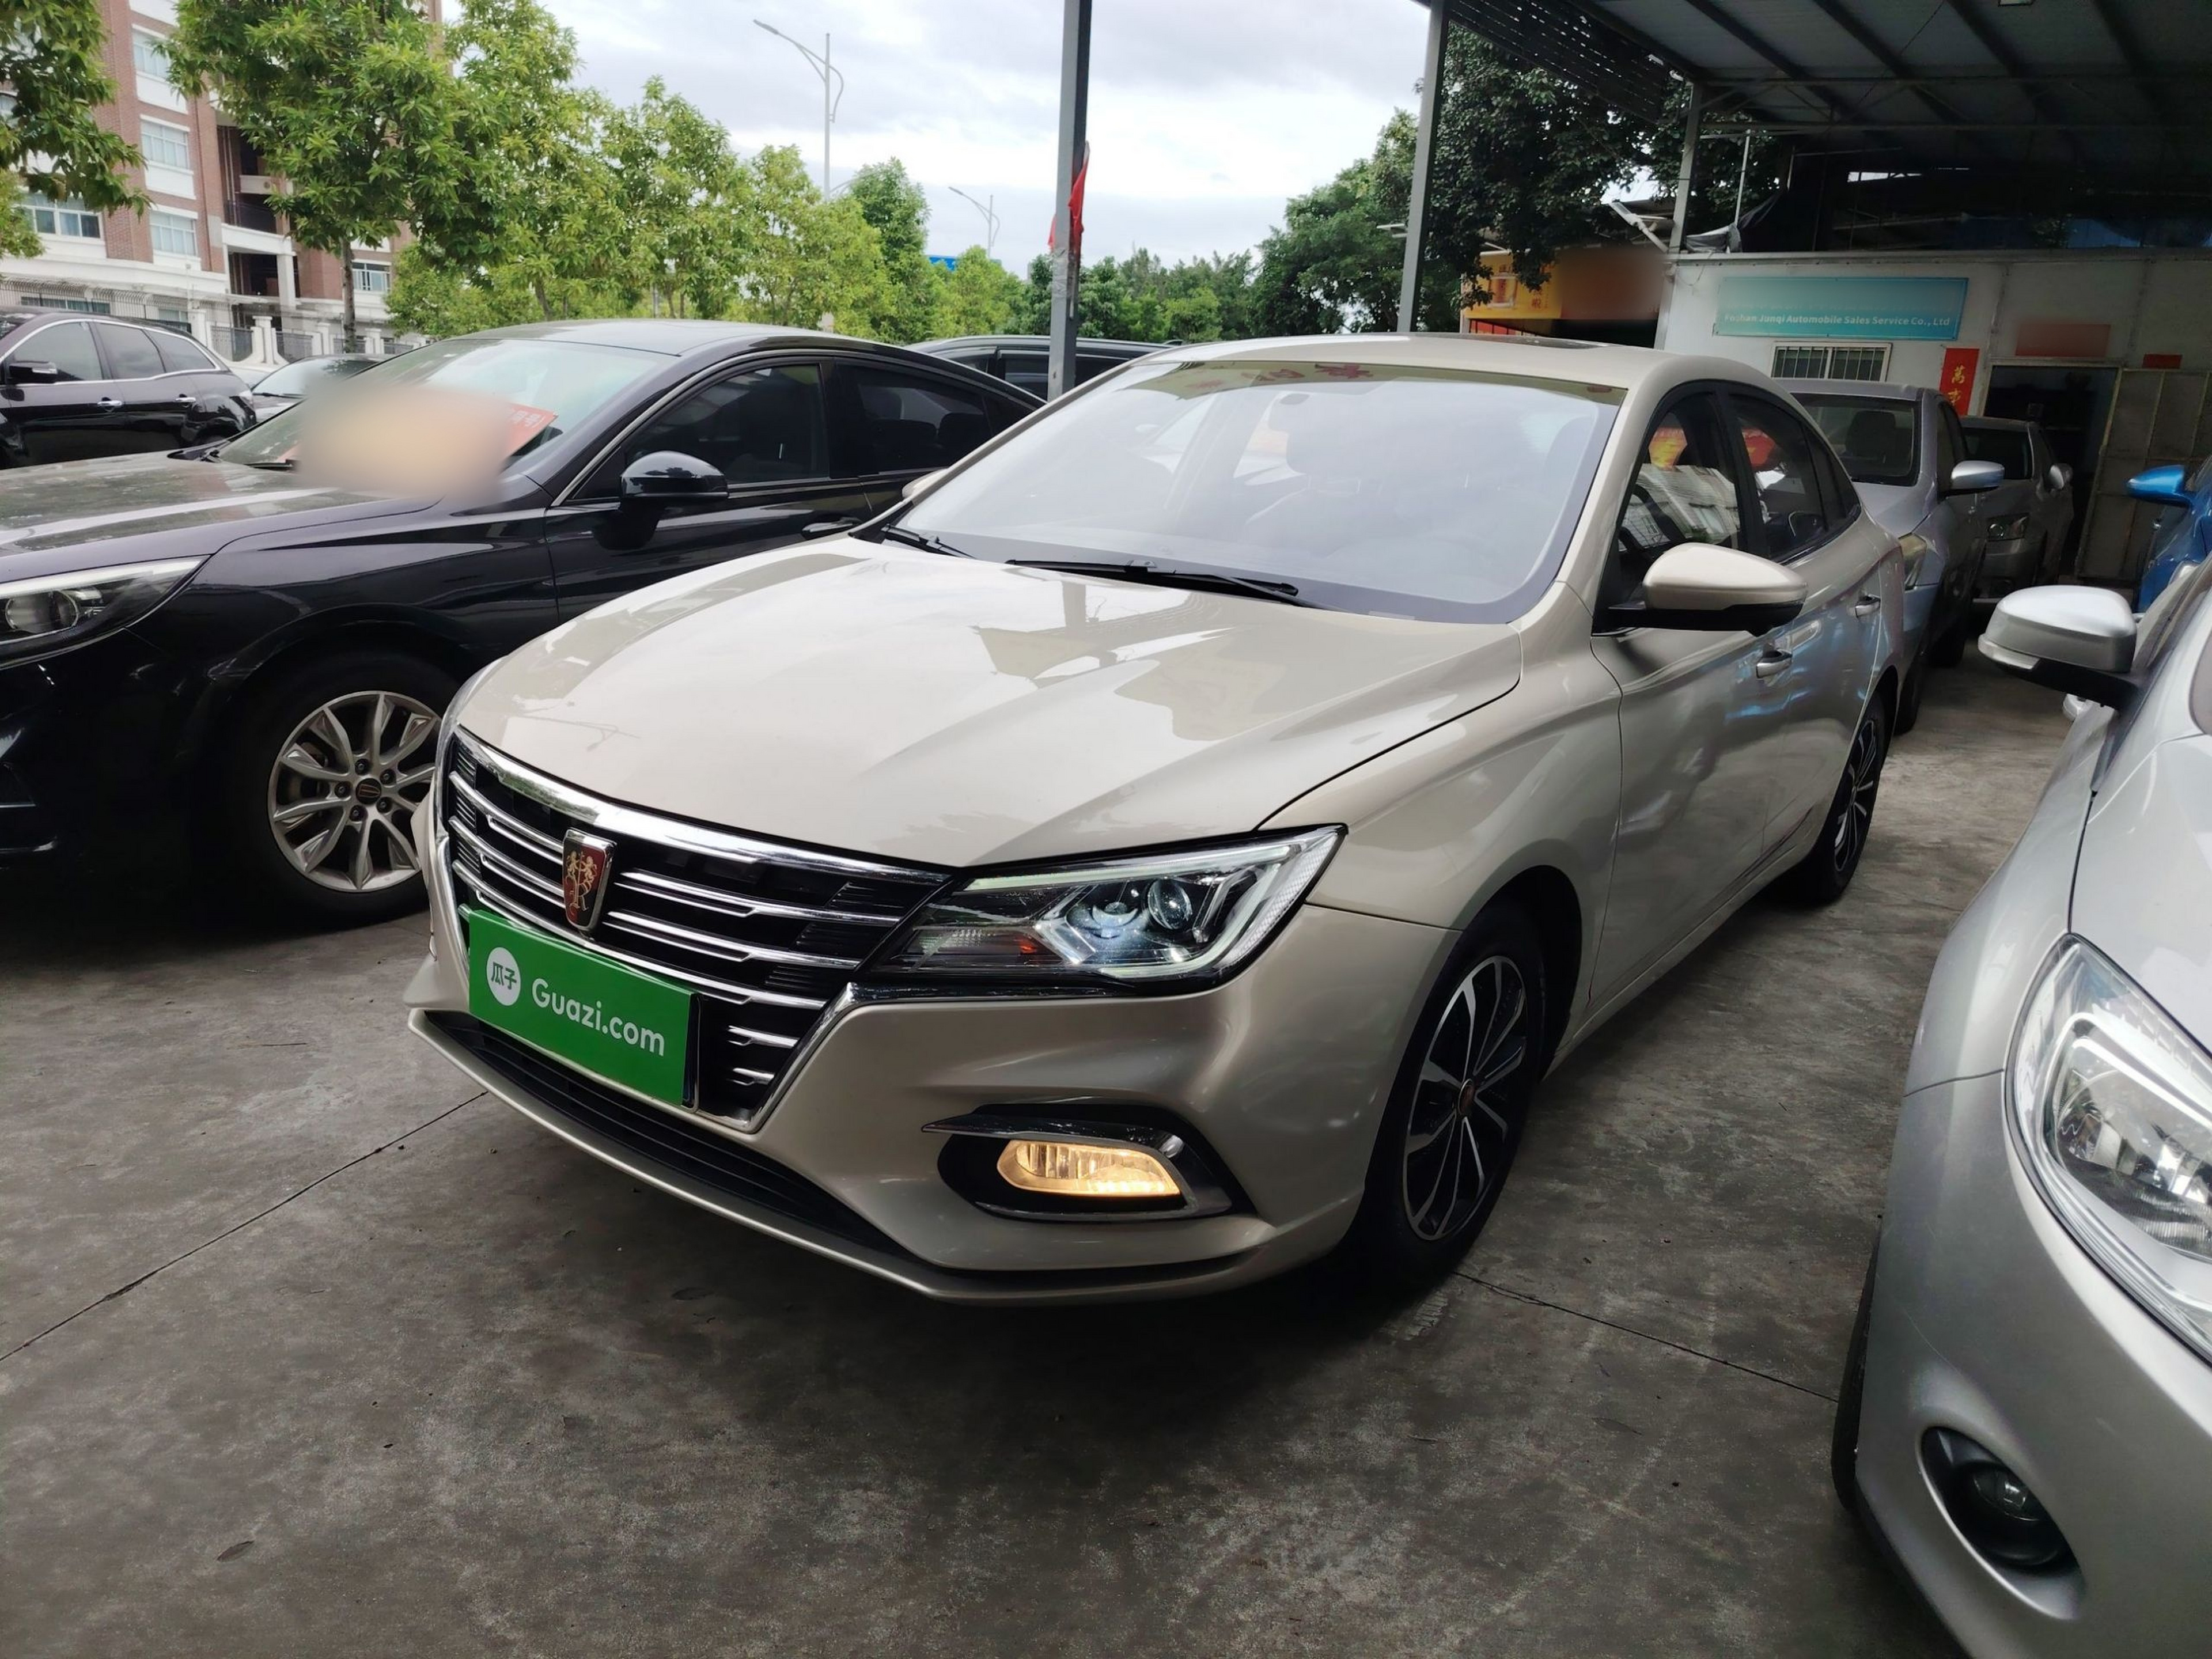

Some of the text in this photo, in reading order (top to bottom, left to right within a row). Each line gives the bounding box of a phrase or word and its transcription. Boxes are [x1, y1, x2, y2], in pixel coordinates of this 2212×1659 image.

[1786, 315, 1843, 324] Automobile
[1844, 316, 1870, 325] Sales
[1872, 317, 1910, 325] Service
[1933, 318, 1950, 326] Ltd
[491, 961, 517, 990] 瓜子
[532, 978, 665, 1056] Guazi.com
